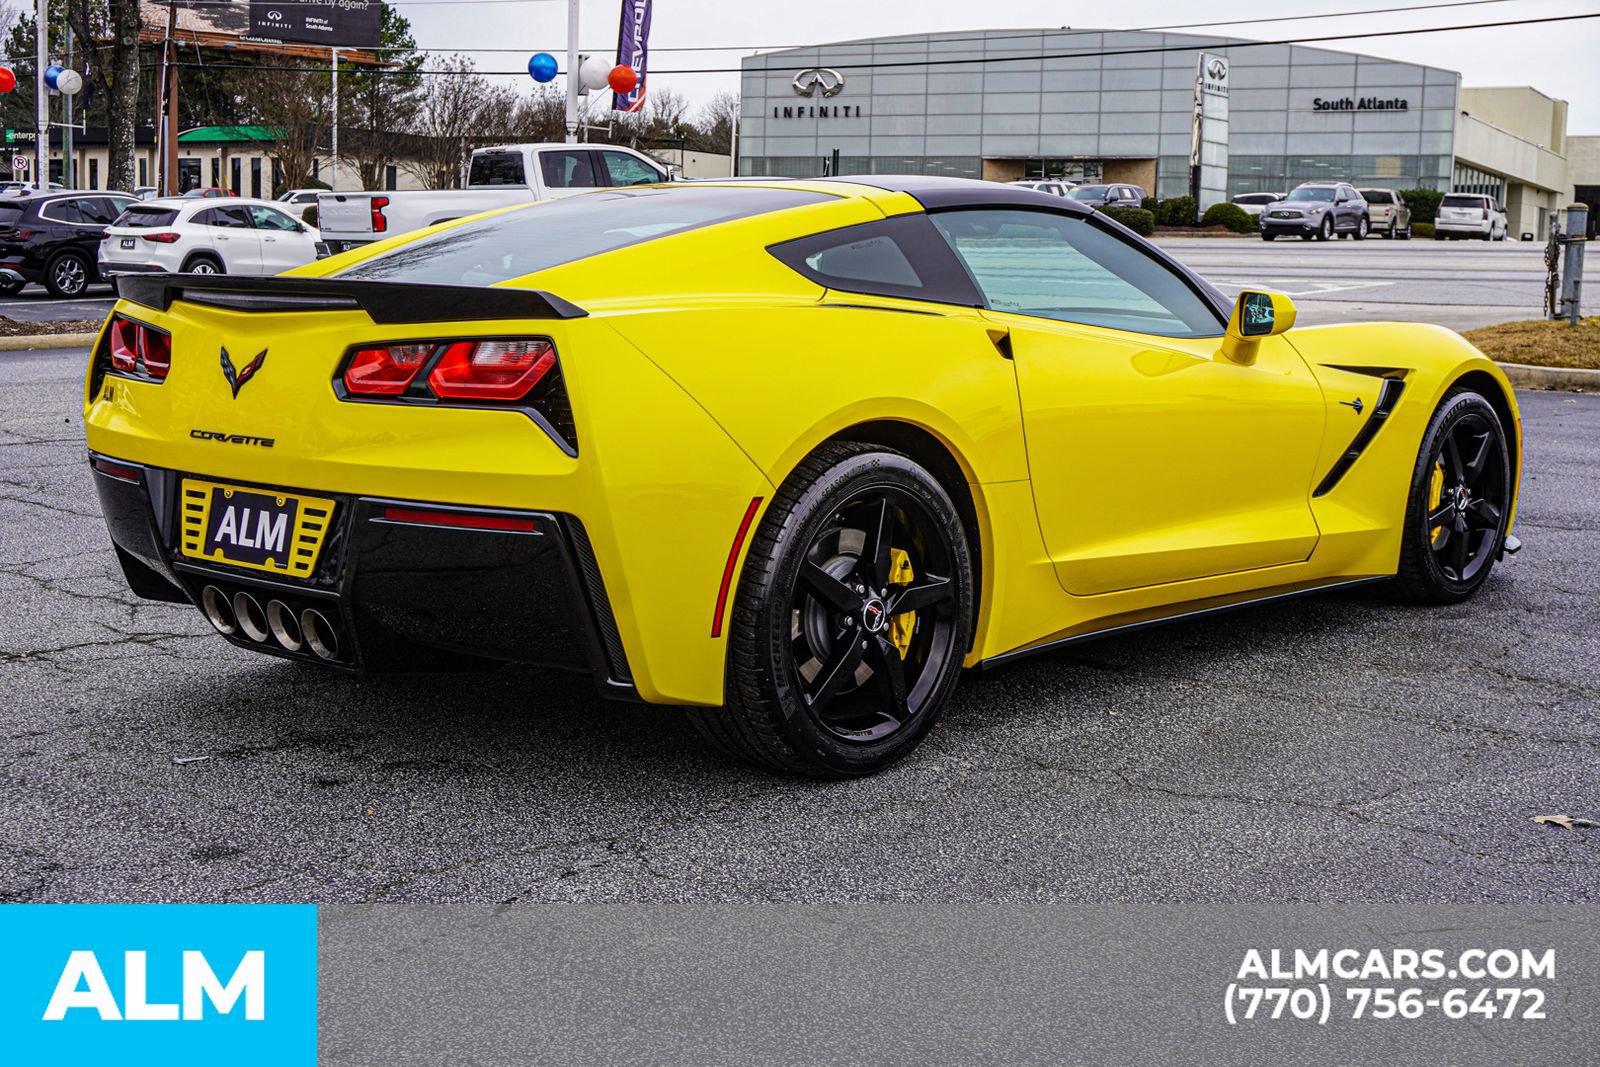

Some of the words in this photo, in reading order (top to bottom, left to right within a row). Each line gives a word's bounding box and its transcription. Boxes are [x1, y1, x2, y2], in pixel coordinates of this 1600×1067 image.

[338, 0, 370, 11] again?
[258, 20, 292, 29] INFINITI
[1313, 97, 1354, 111] South
[1357, 96, 1408, 110] Atlanta
[774, 105, 860, 118] INFINITI
[190, 429, 275, 447] CORVETTE
[214, 505, 288, 553] ALM
